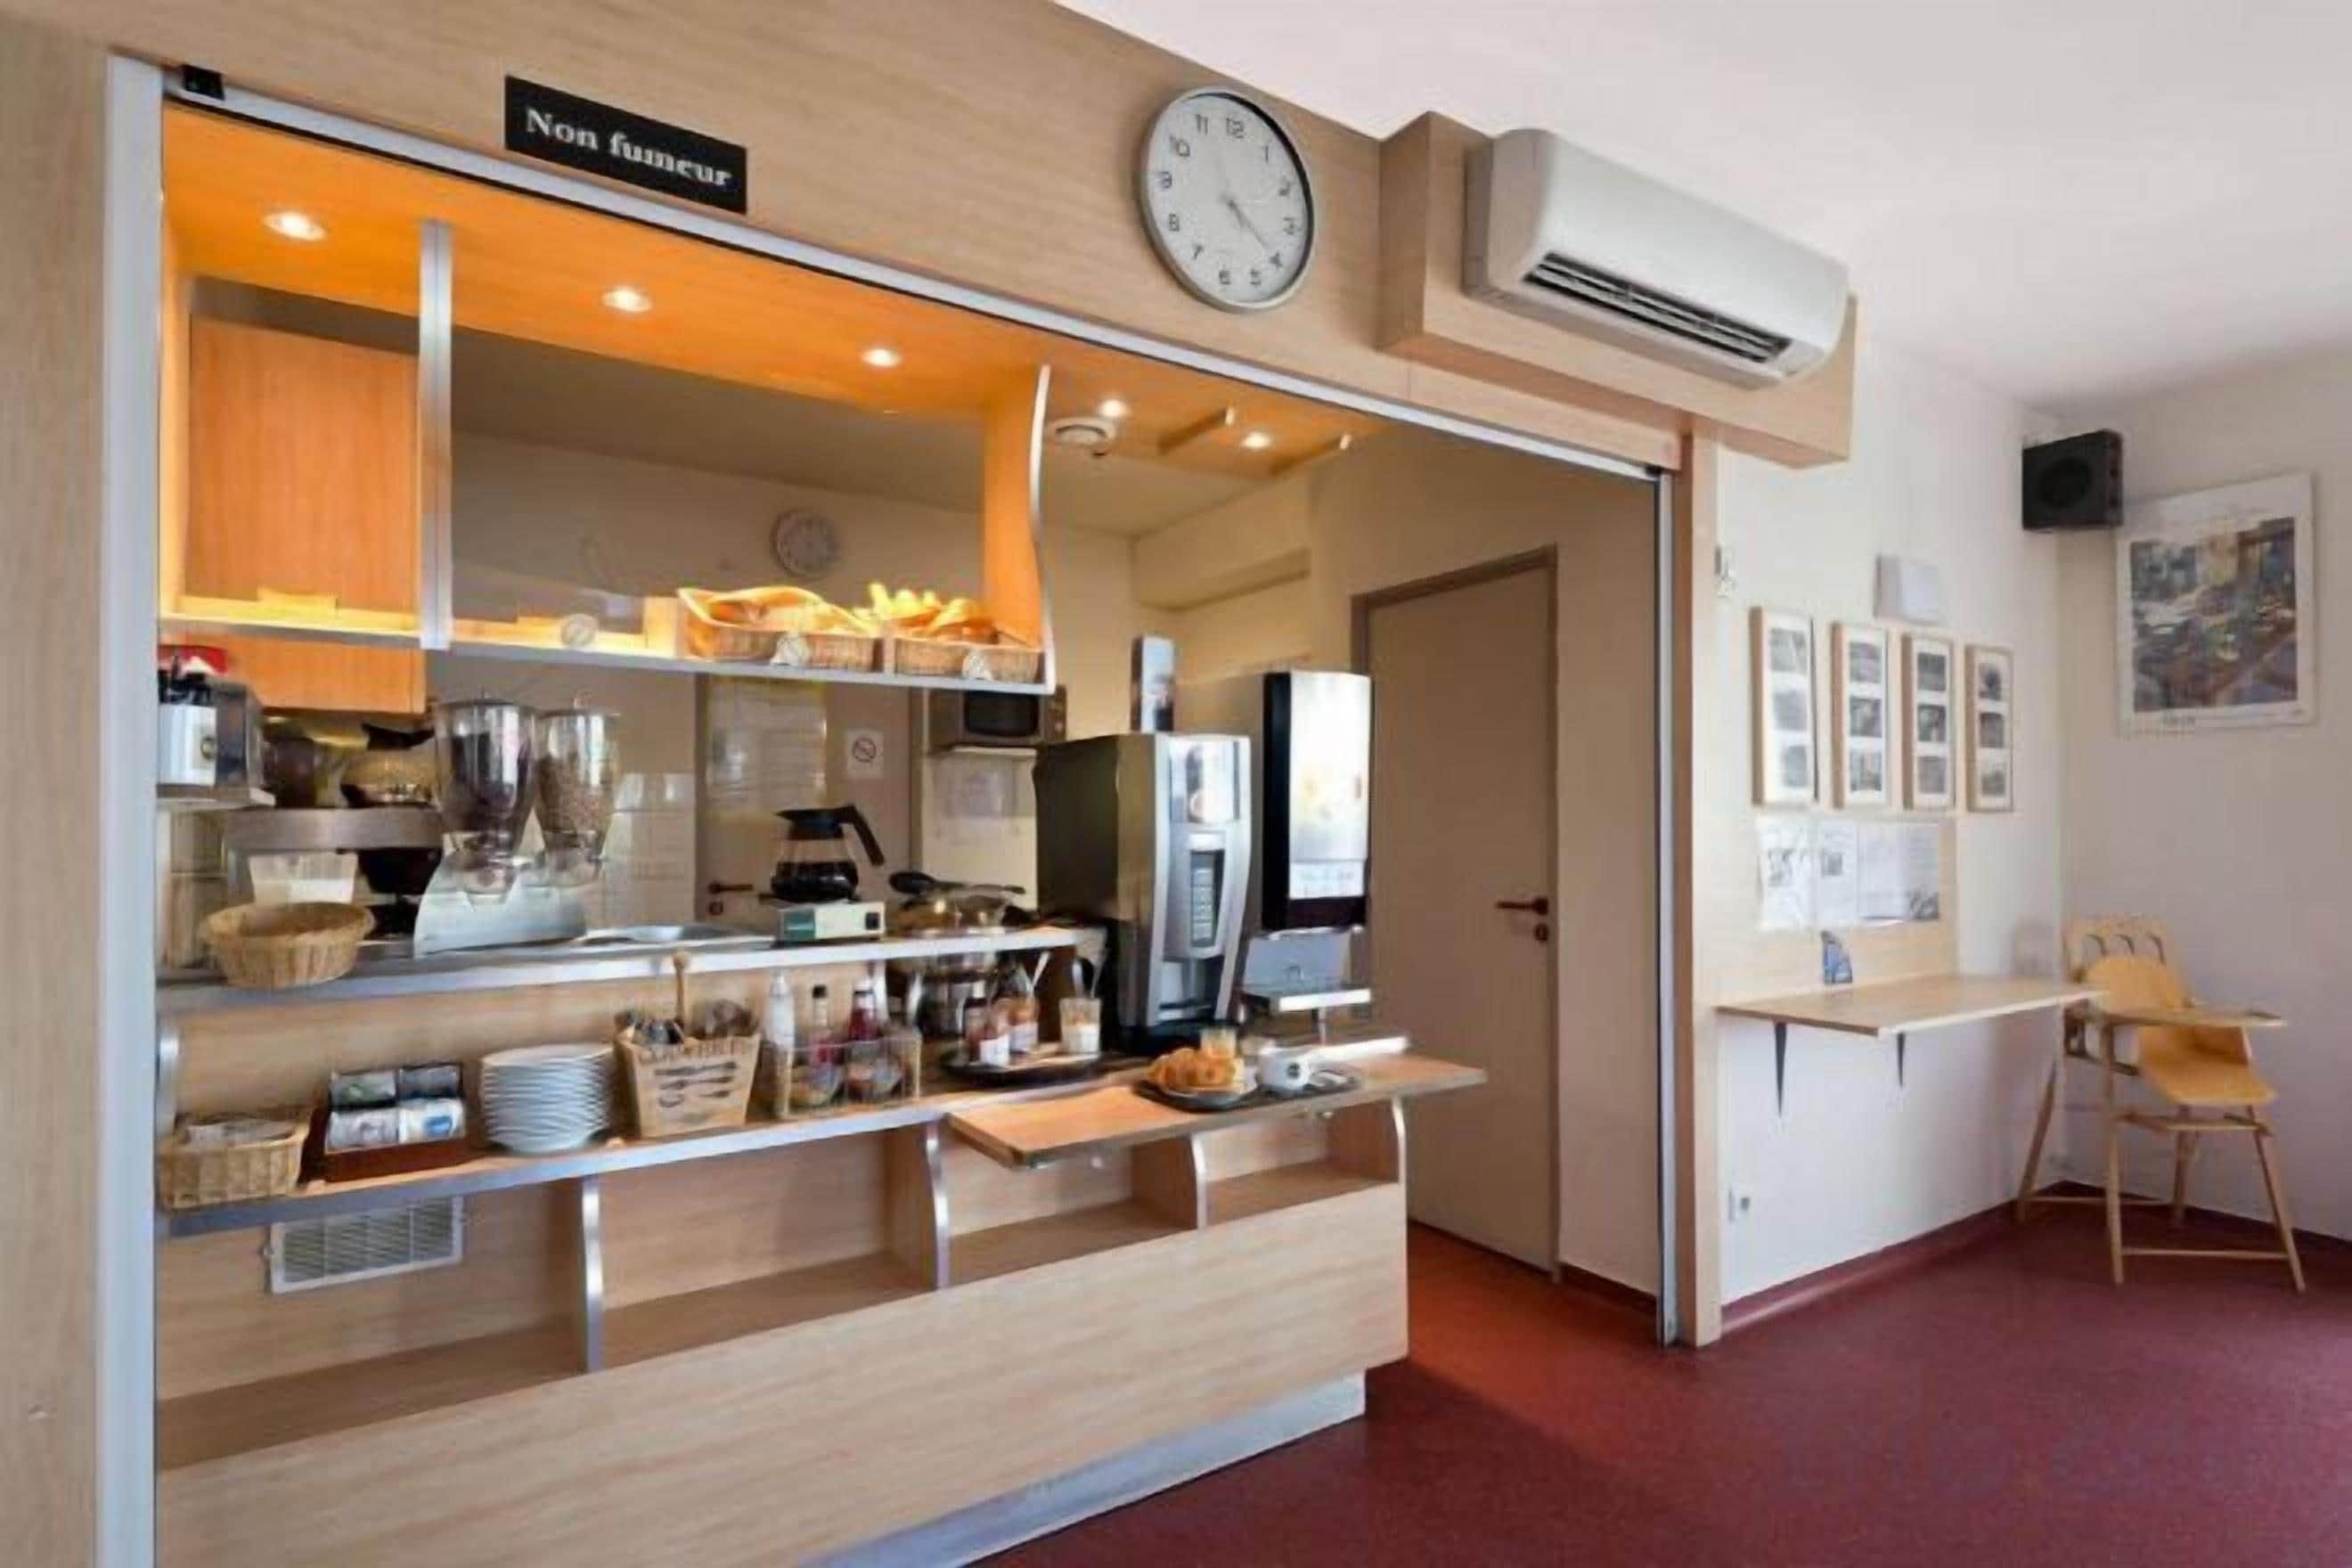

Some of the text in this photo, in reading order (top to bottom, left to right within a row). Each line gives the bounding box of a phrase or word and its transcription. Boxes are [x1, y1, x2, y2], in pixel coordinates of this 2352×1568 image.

[525, 106, 733, 186] Non fumeur
[1226, 118, 1245, 138] 12
